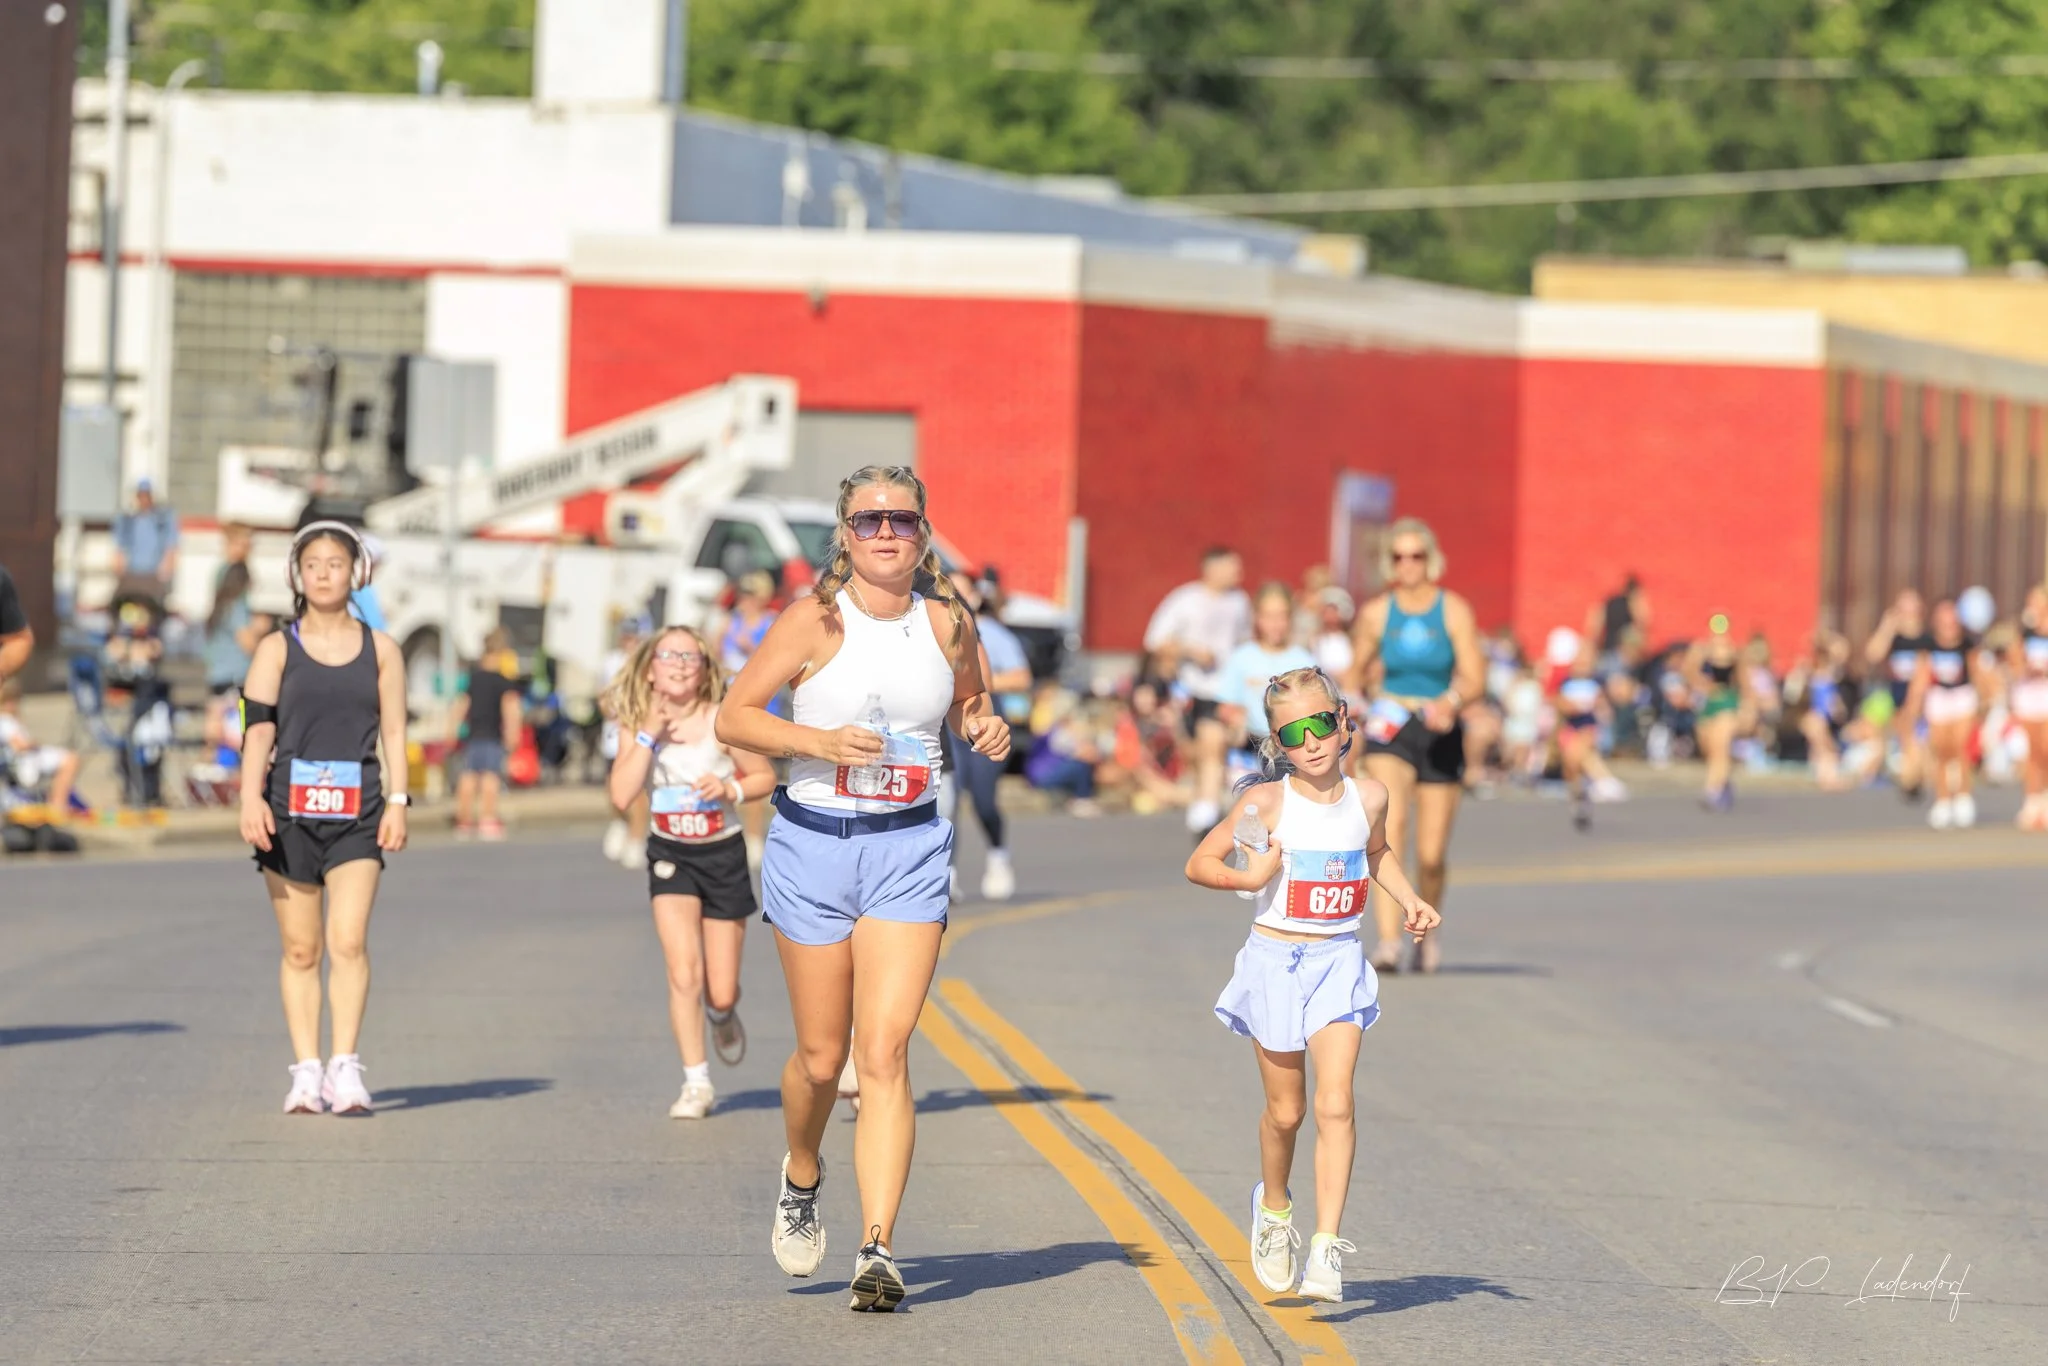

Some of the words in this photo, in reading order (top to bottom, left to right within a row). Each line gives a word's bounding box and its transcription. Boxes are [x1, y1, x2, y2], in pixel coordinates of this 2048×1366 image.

[304, 787, 345, 812] 290
[667, 813, 709, 837] 560
[1325, 865, 1346, 876] ROUTE
[1309, 885, 1355, 914] 626
